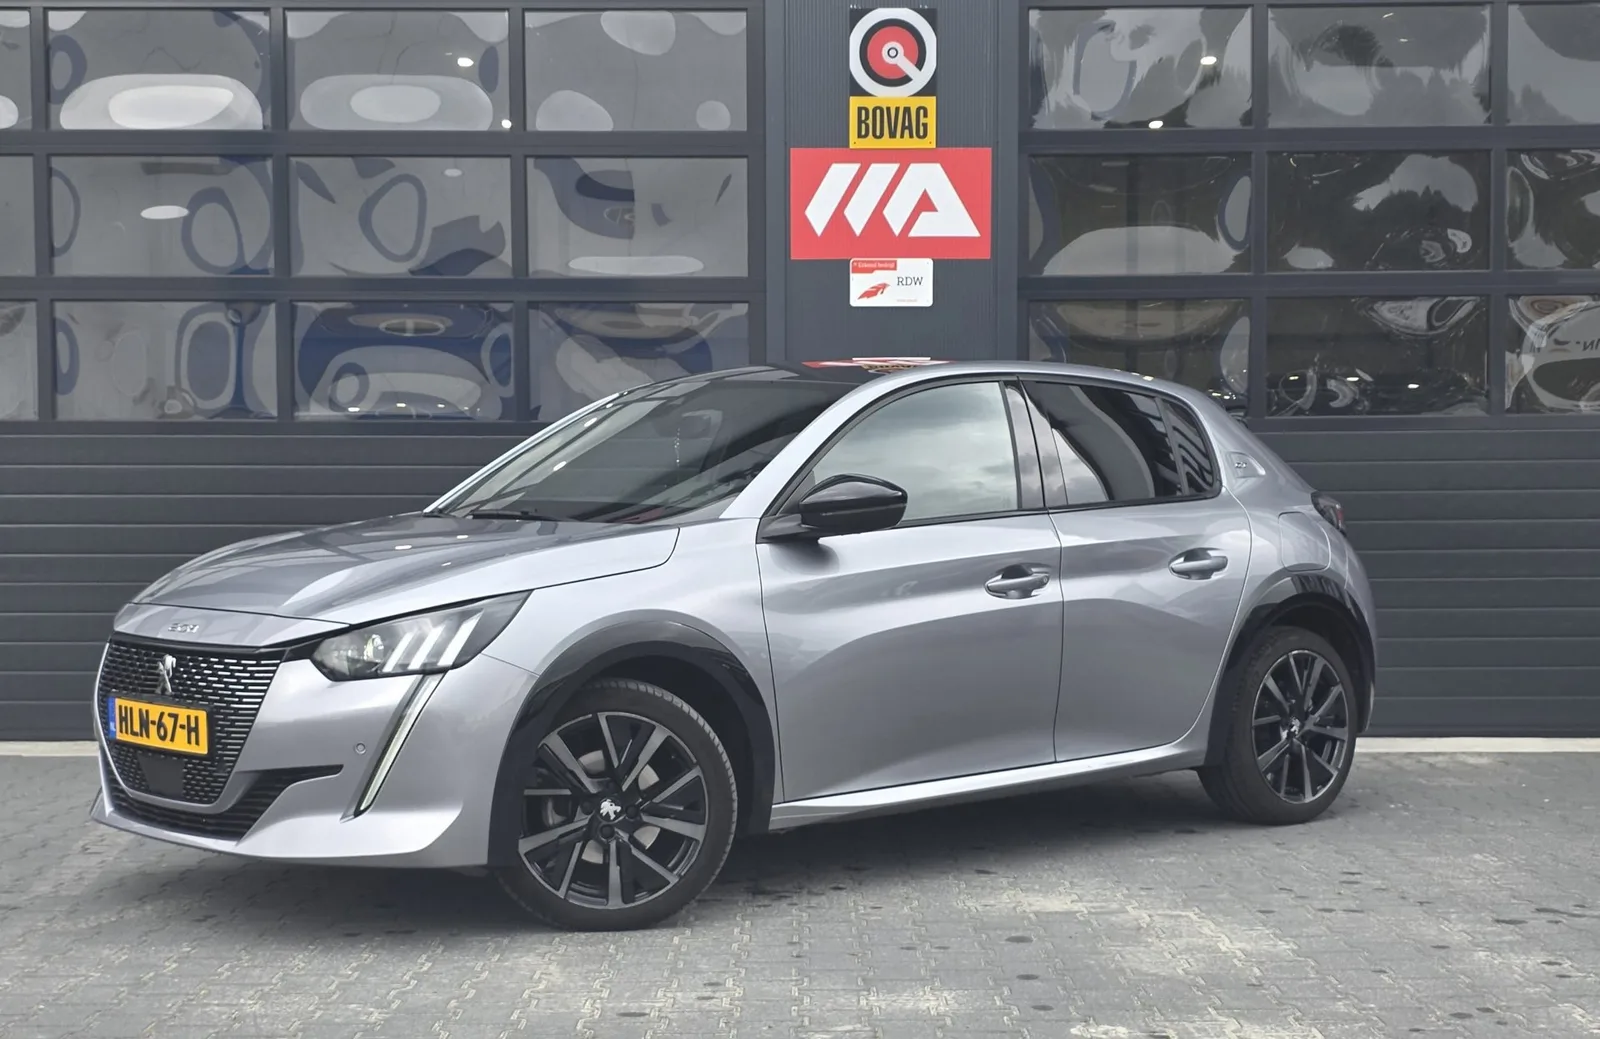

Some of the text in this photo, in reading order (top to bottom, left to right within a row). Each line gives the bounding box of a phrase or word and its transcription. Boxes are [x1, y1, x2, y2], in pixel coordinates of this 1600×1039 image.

[857, 106, 928, 140] BOVAG
[897, 276, 924, 286] RDW
[118, 705, 200, 746] HLN-67-H
